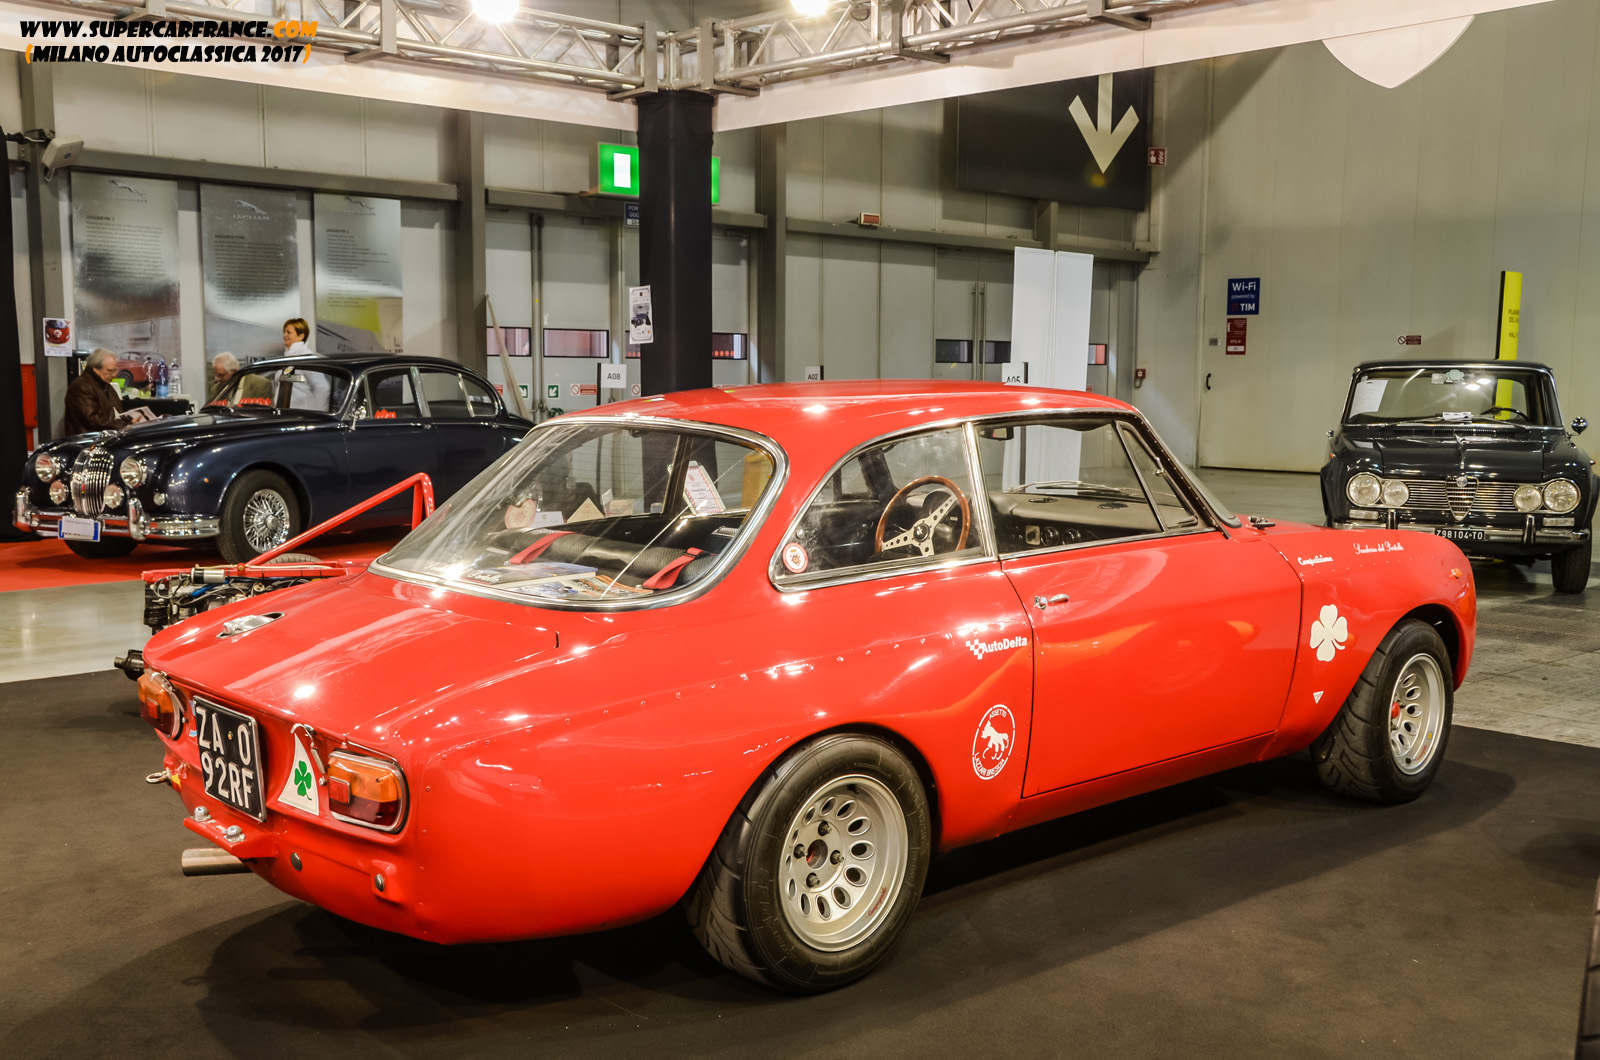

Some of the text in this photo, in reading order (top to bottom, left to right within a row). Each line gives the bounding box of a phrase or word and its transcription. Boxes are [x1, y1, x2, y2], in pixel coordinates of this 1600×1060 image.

[1232, 281, 1256, 291] Wi-Fi
[1240, 303, 1255, 311] TIM
[982, 636, 1028, 654] AutoDelta
[989, 708, 1007, 720] ASSETTO
[196, 706, 225, 755] ZA
[200, 750, 255, 810] 92RF
